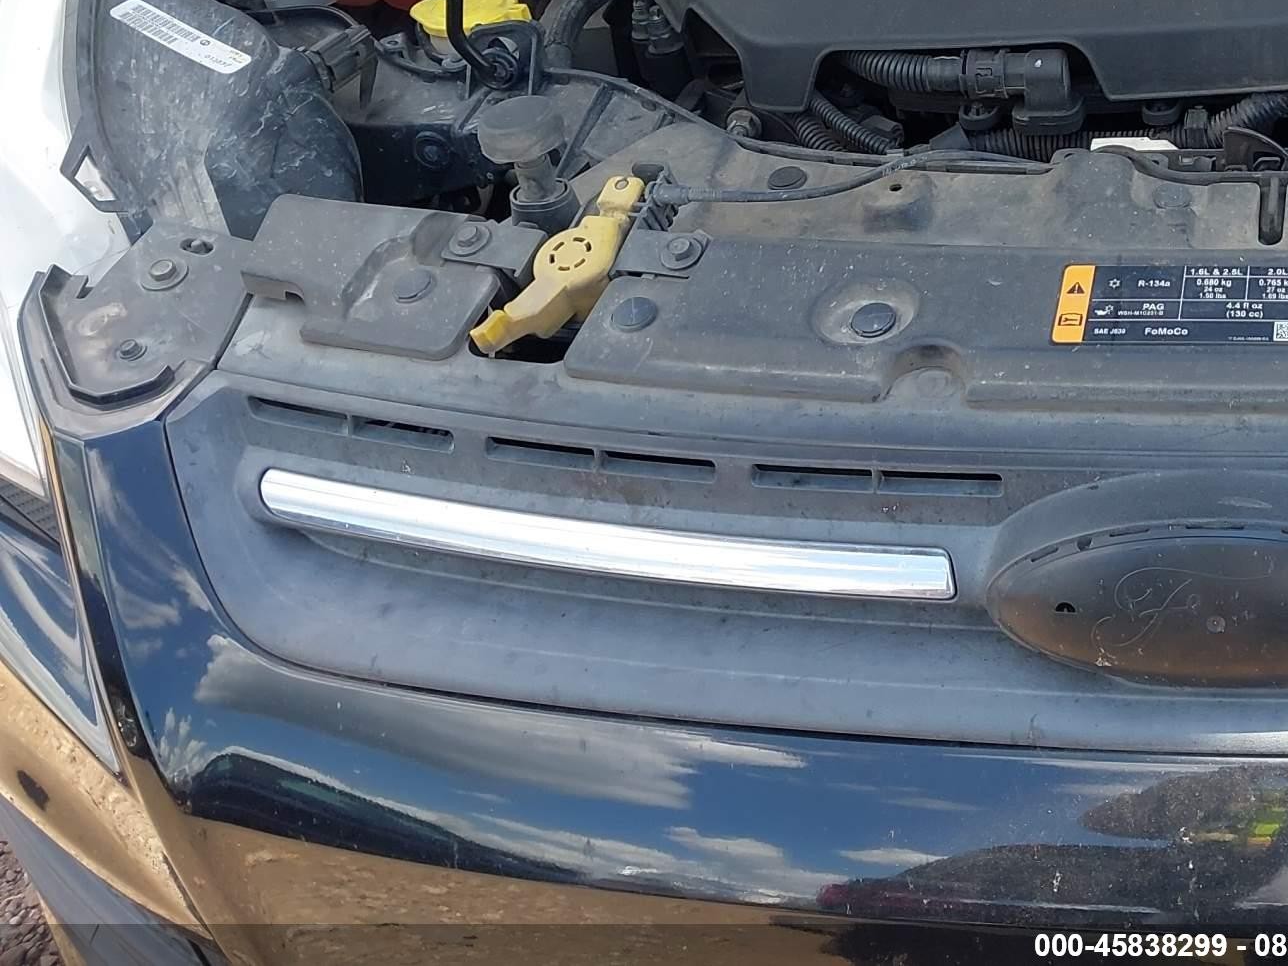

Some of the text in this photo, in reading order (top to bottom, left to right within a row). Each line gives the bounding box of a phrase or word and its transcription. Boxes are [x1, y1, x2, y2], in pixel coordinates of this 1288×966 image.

[1267, 268, 1288, 276] 2.0L
[1137, 279, 1171, 287] R-134a
[1221, 279, 1232, 287] kg
[1226, 310, 1264, 318] (130 cc)
[1144, 327, 1189, 335] FoMoCo
